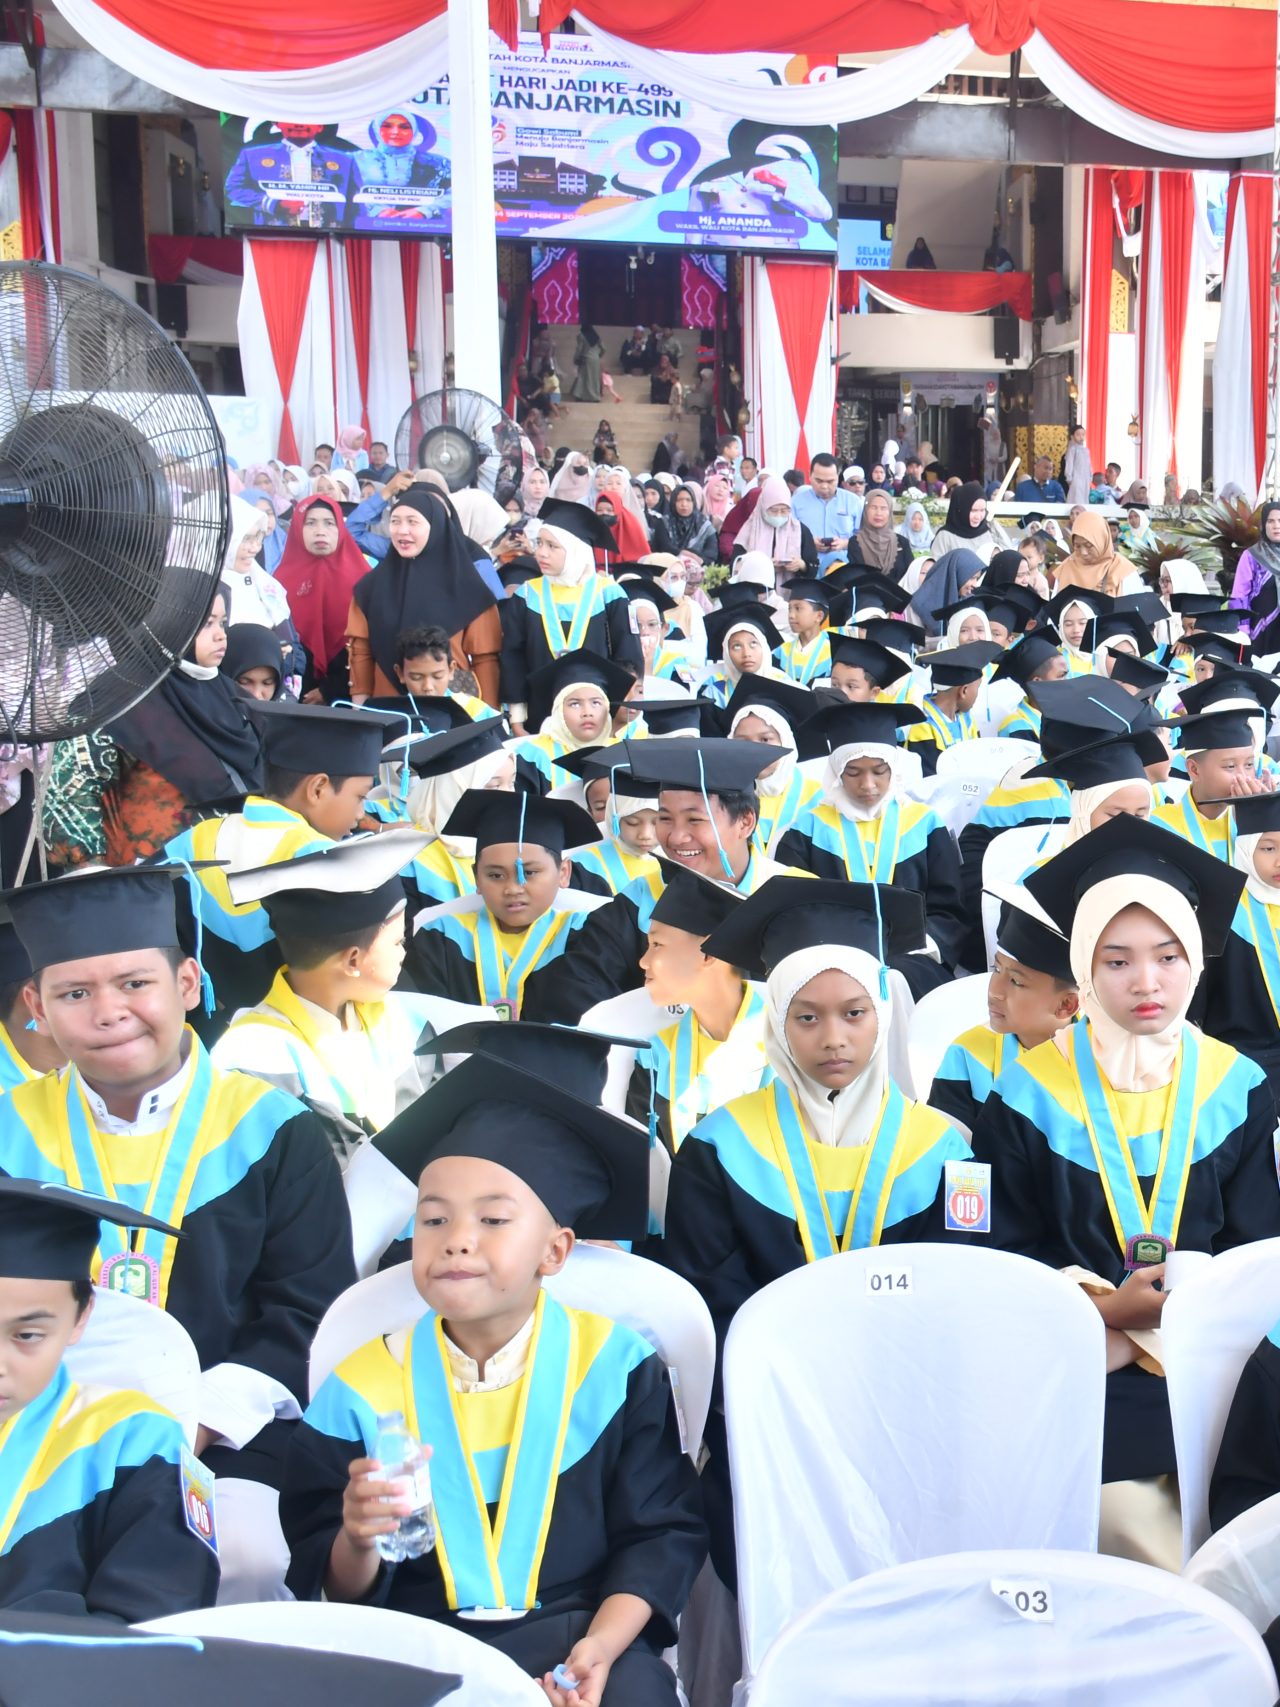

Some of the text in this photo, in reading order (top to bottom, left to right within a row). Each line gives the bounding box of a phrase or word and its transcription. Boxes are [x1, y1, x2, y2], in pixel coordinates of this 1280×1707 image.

[515, 55, 547, 63] KOTA
[500, 75, 546, 90] HARI
[552, 77, 597, 93] JADI
[490, 91, 682, 118] ANJARMASIN
[699, 215, 772, 227] Hj. ANANDA
[855, 256, 879, 267] KOTA
[962, 784, 979, 793] 052
[956, 1194, 979, 1220] 019
[870, 1273, 909, 1291] 014
[191, 1493, 210, 1533] 016
[999, 1590, 1049, 1614] 03
